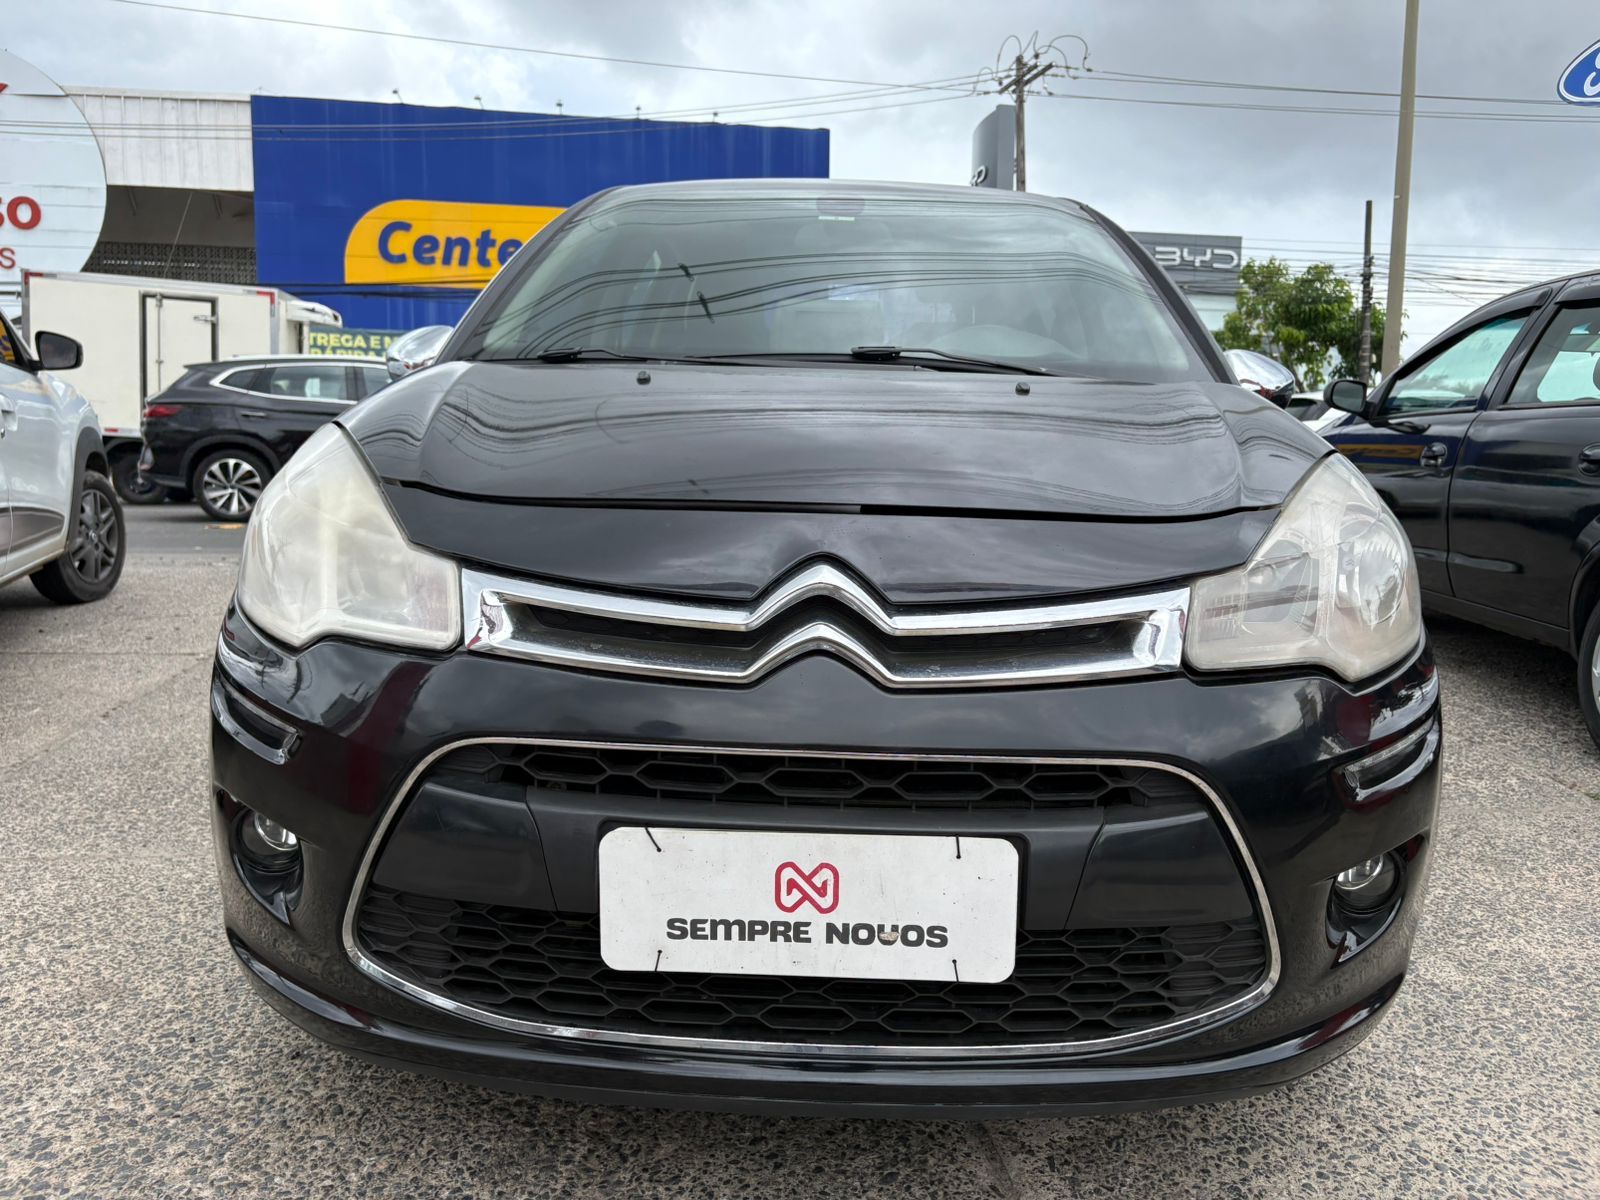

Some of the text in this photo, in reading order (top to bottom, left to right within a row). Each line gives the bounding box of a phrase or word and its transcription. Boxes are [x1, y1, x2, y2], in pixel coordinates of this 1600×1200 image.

[0, 196, 42, 230] O
[378, 221, 525, 268] Cente
[1155, 246, 1239, 269] BYD
[666, 918, 812, 943] SEMPRE
